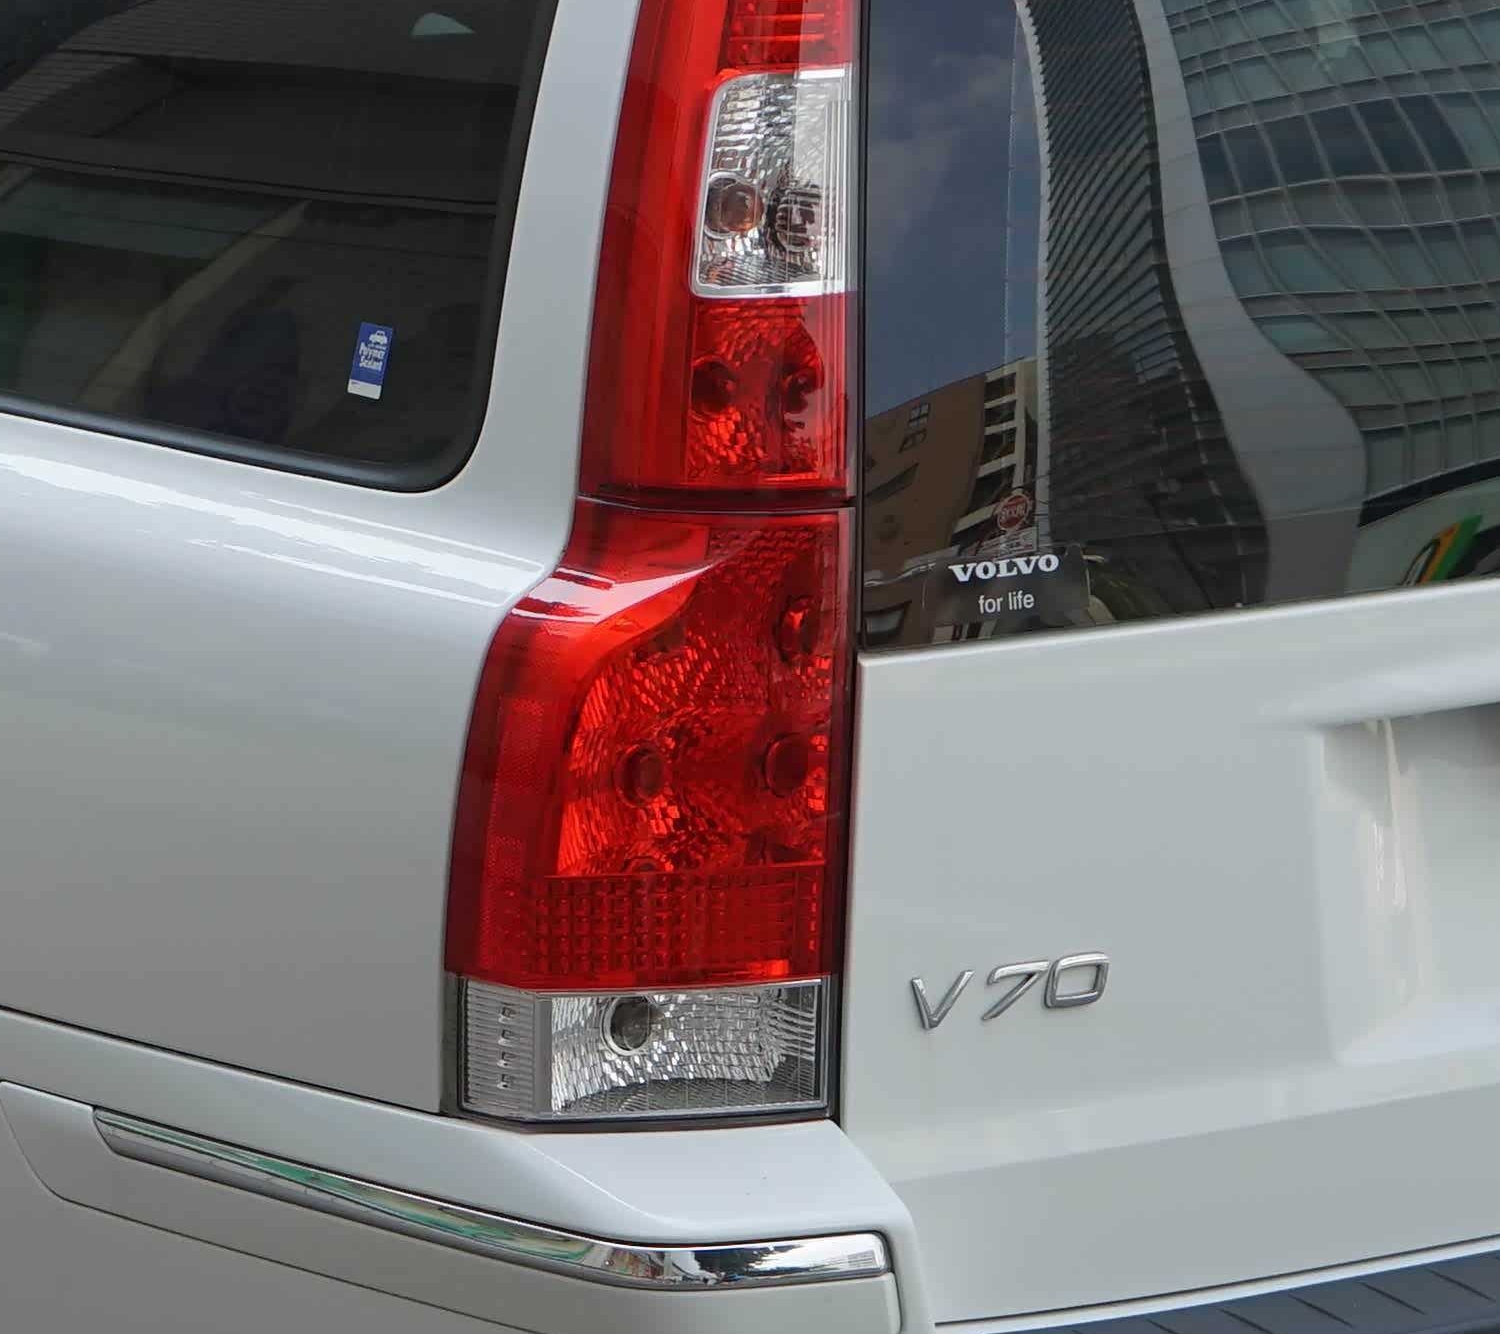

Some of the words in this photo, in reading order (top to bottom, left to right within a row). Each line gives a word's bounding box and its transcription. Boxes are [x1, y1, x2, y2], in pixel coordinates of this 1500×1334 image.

[948, 553, 1060, 583] VOLVO
[978, 595, 1003, 614] for
[1008, 589, 1035, 611] life
[910, 951, 1110, 1030] V70
